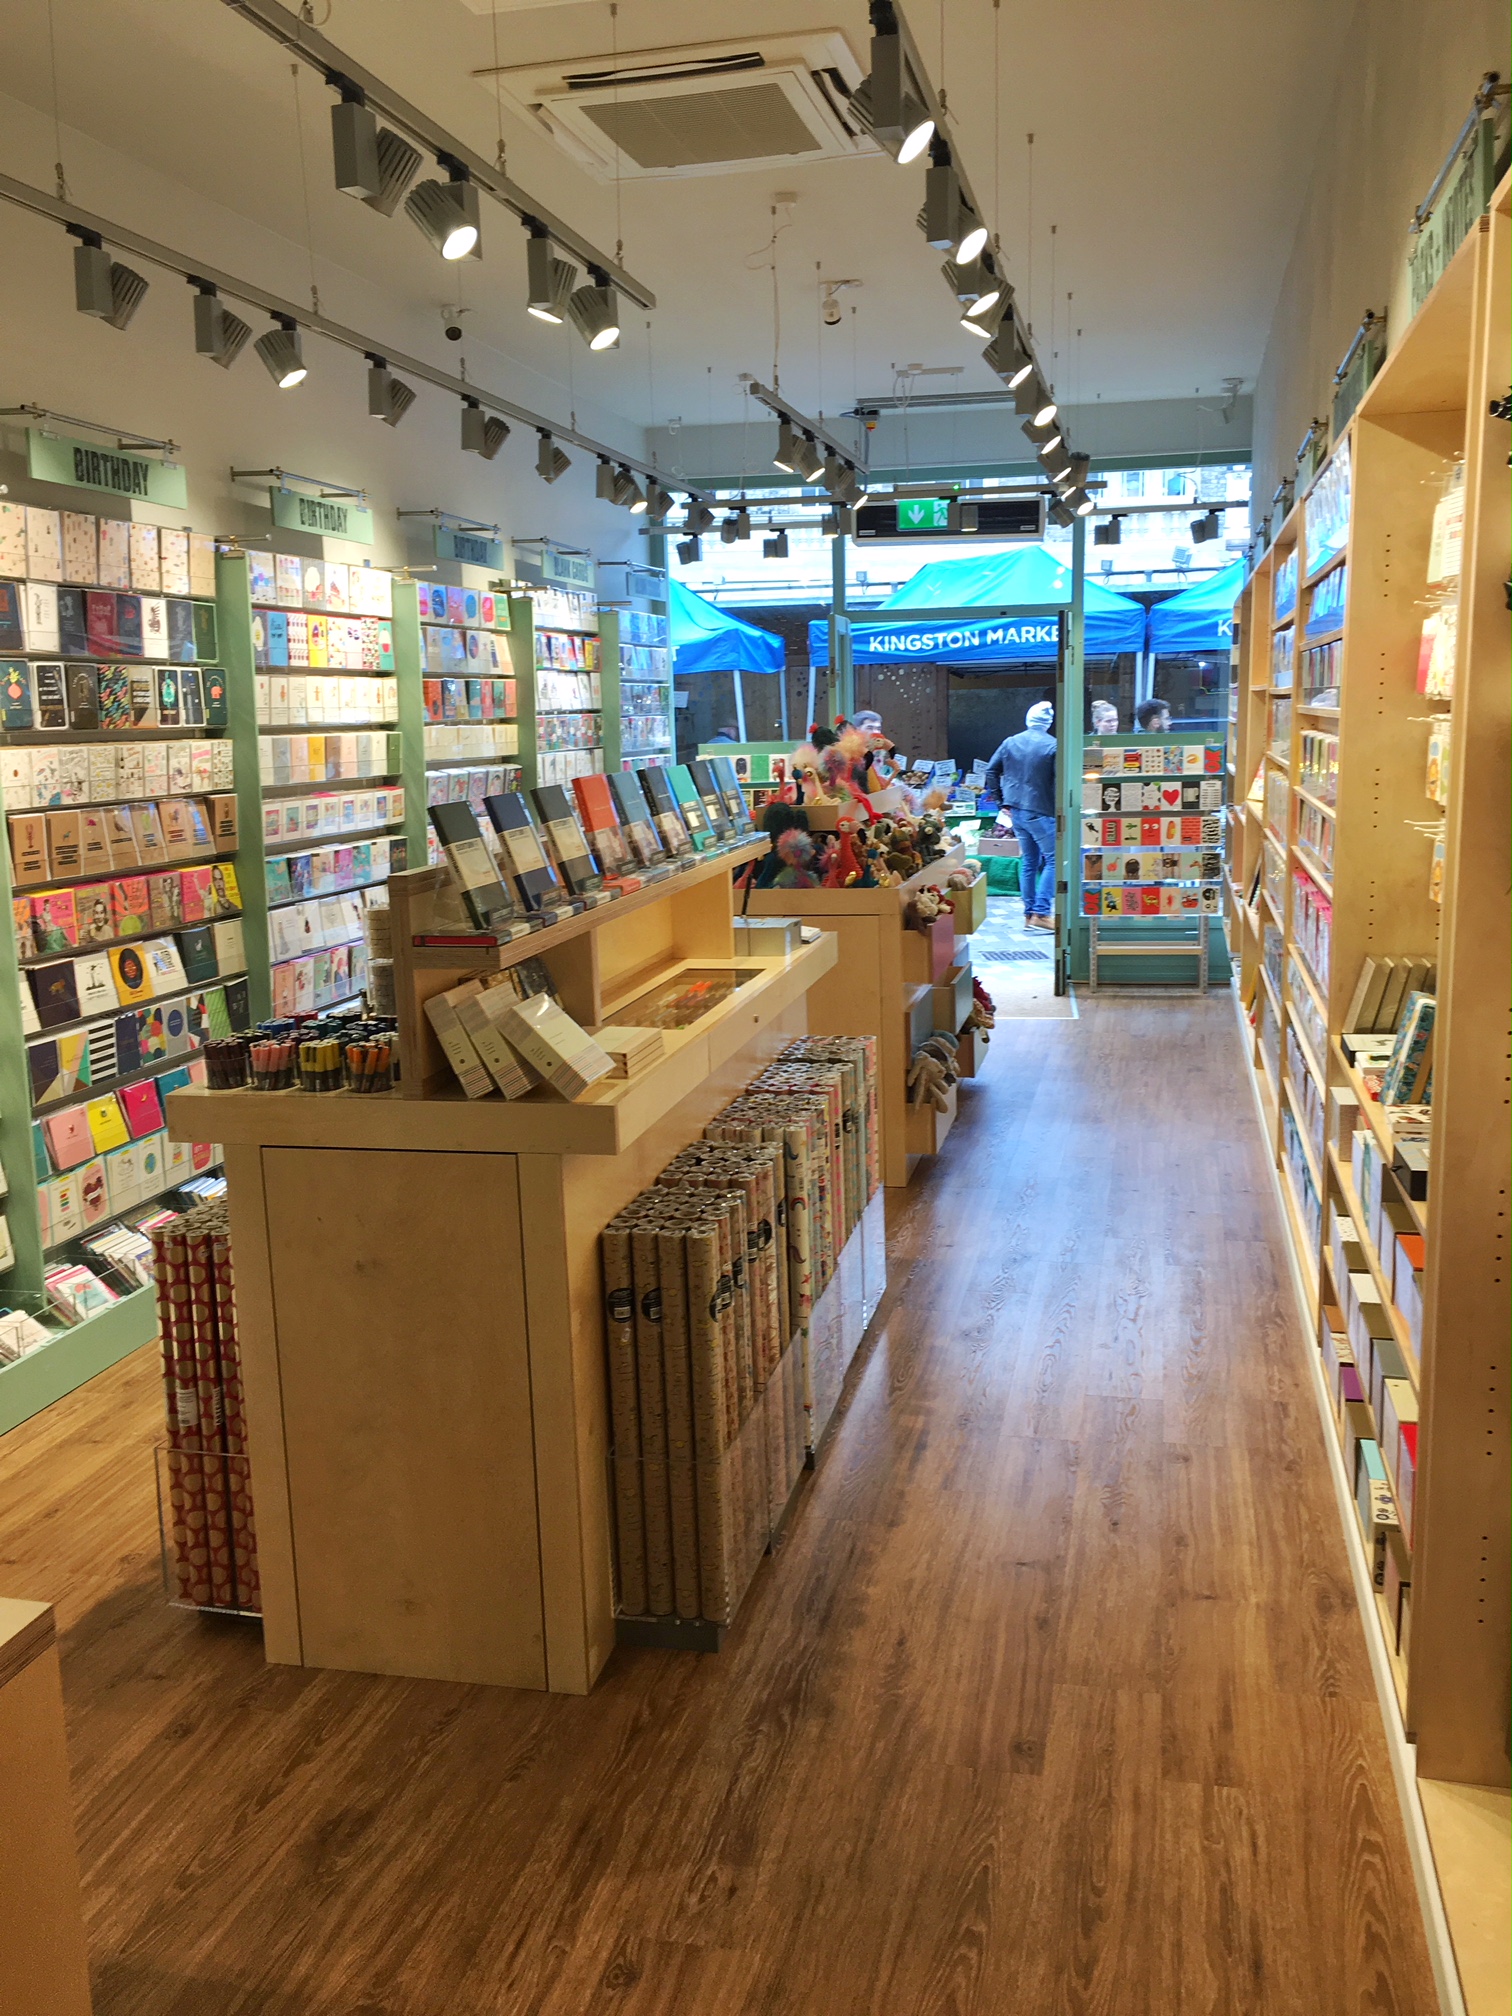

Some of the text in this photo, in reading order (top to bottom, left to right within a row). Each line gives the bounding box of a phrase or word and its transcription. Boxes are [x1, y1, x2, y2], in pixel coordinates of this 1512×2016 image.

[73, 447, 149, 496] BIRTHDAY
[299, 498, 348, 534] BIRTHDAY
[869, 631, 980, 652] KINGSTON
[1107, 821, 1118, 843] HELLO
